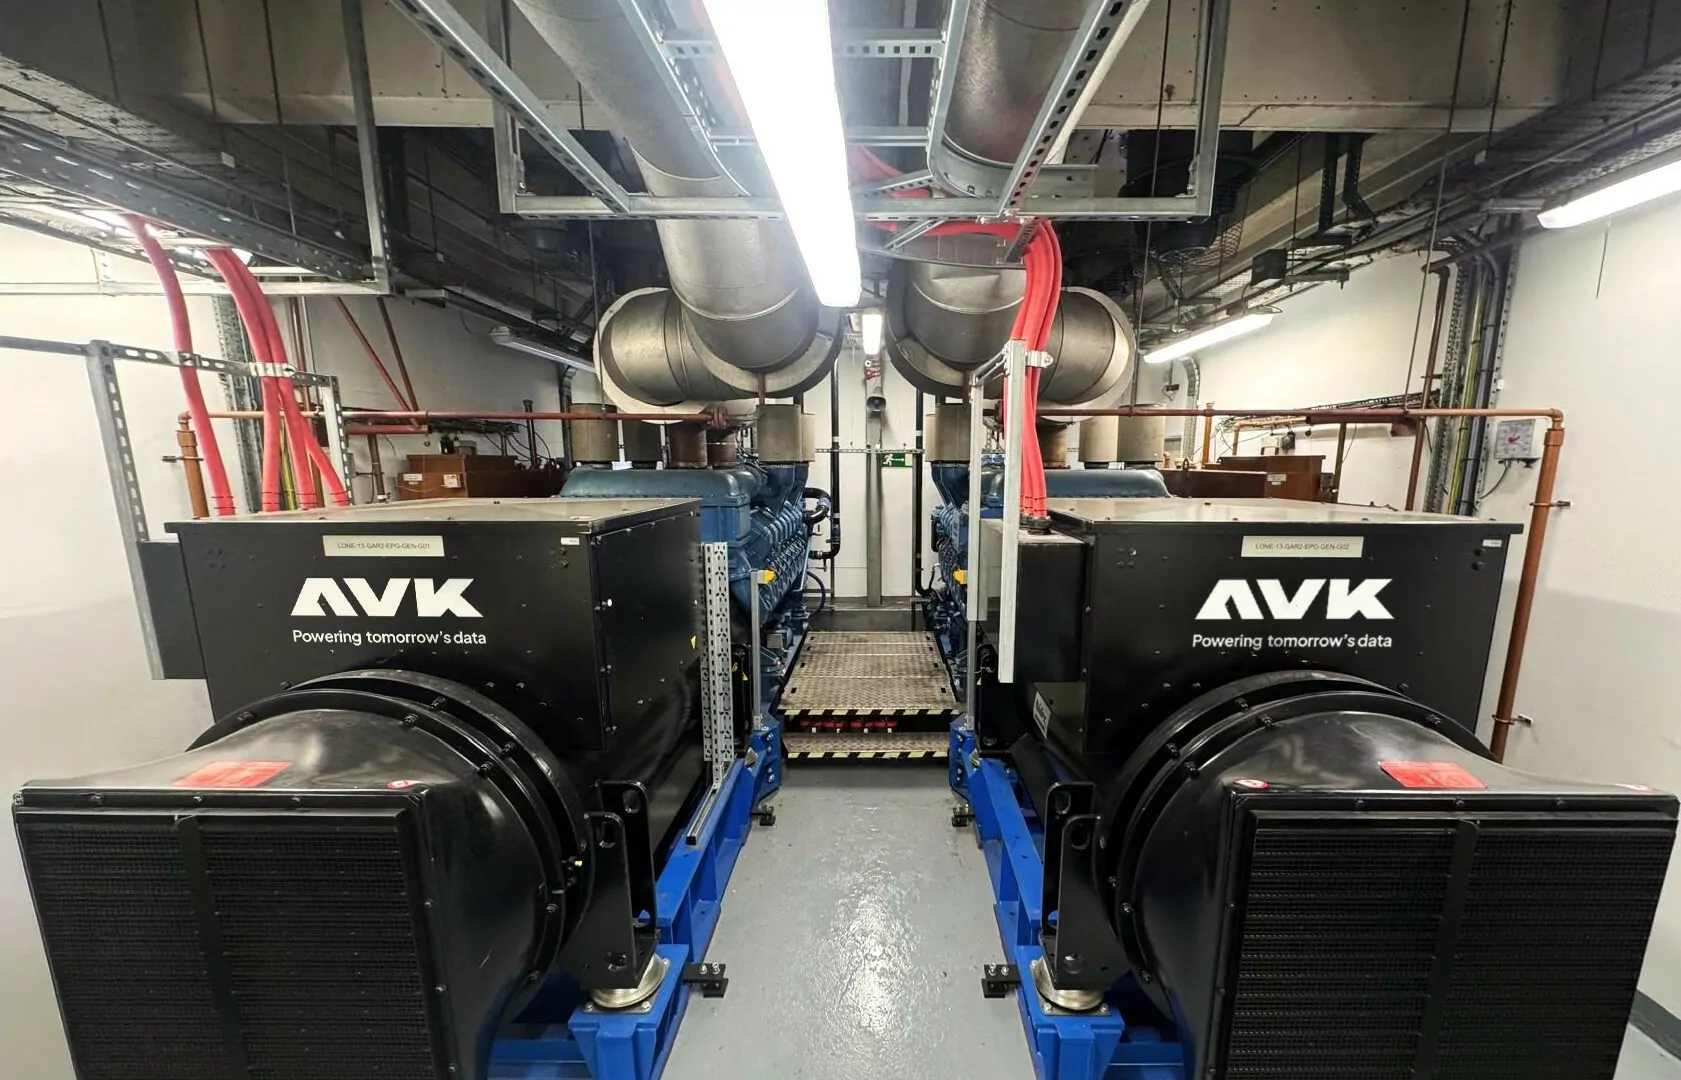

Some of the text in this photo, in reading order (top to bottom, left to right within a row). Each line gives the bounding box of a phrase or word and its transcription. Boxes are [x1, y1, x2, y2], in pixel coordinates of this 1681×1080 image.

[290, 577, 484, 617] AVK
[1194, 578, 1395, 619] AVK
[292, 629, 486, 646] Powering tomorrow’s data
[1192, 634, 1392, 650] Powering tomorrow’s data
